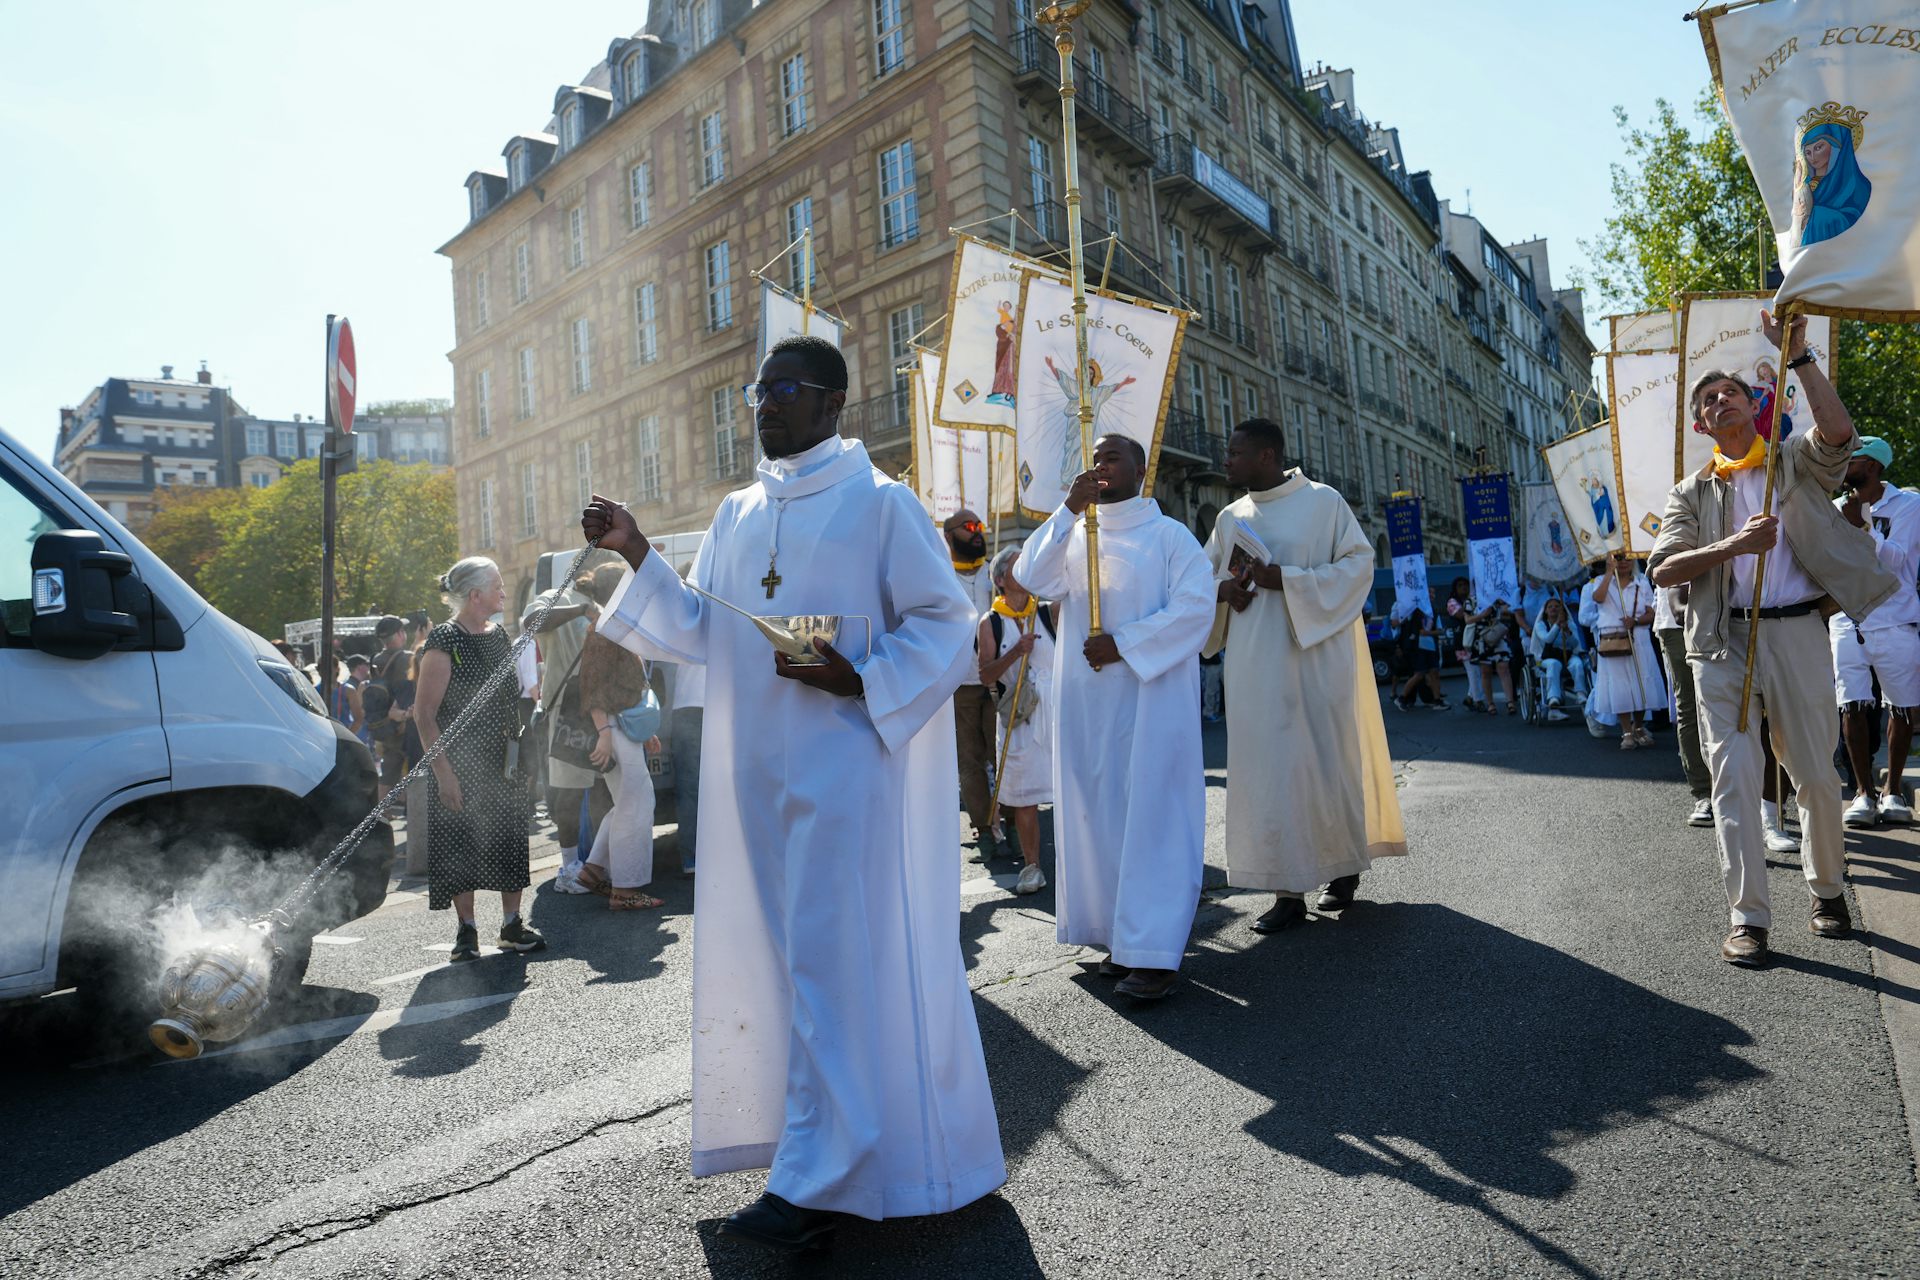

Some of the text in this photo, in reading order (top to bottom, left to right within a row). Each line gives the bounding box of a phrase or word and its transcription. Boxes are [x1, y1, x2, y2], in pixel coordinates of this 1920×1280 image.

[1740, 36, 1799, 103] MATER
[1036, 319, 1054, 332] Le
[1688, 340, 1717, 366] Notre
[1719, 328, 1751, 342] Dame
